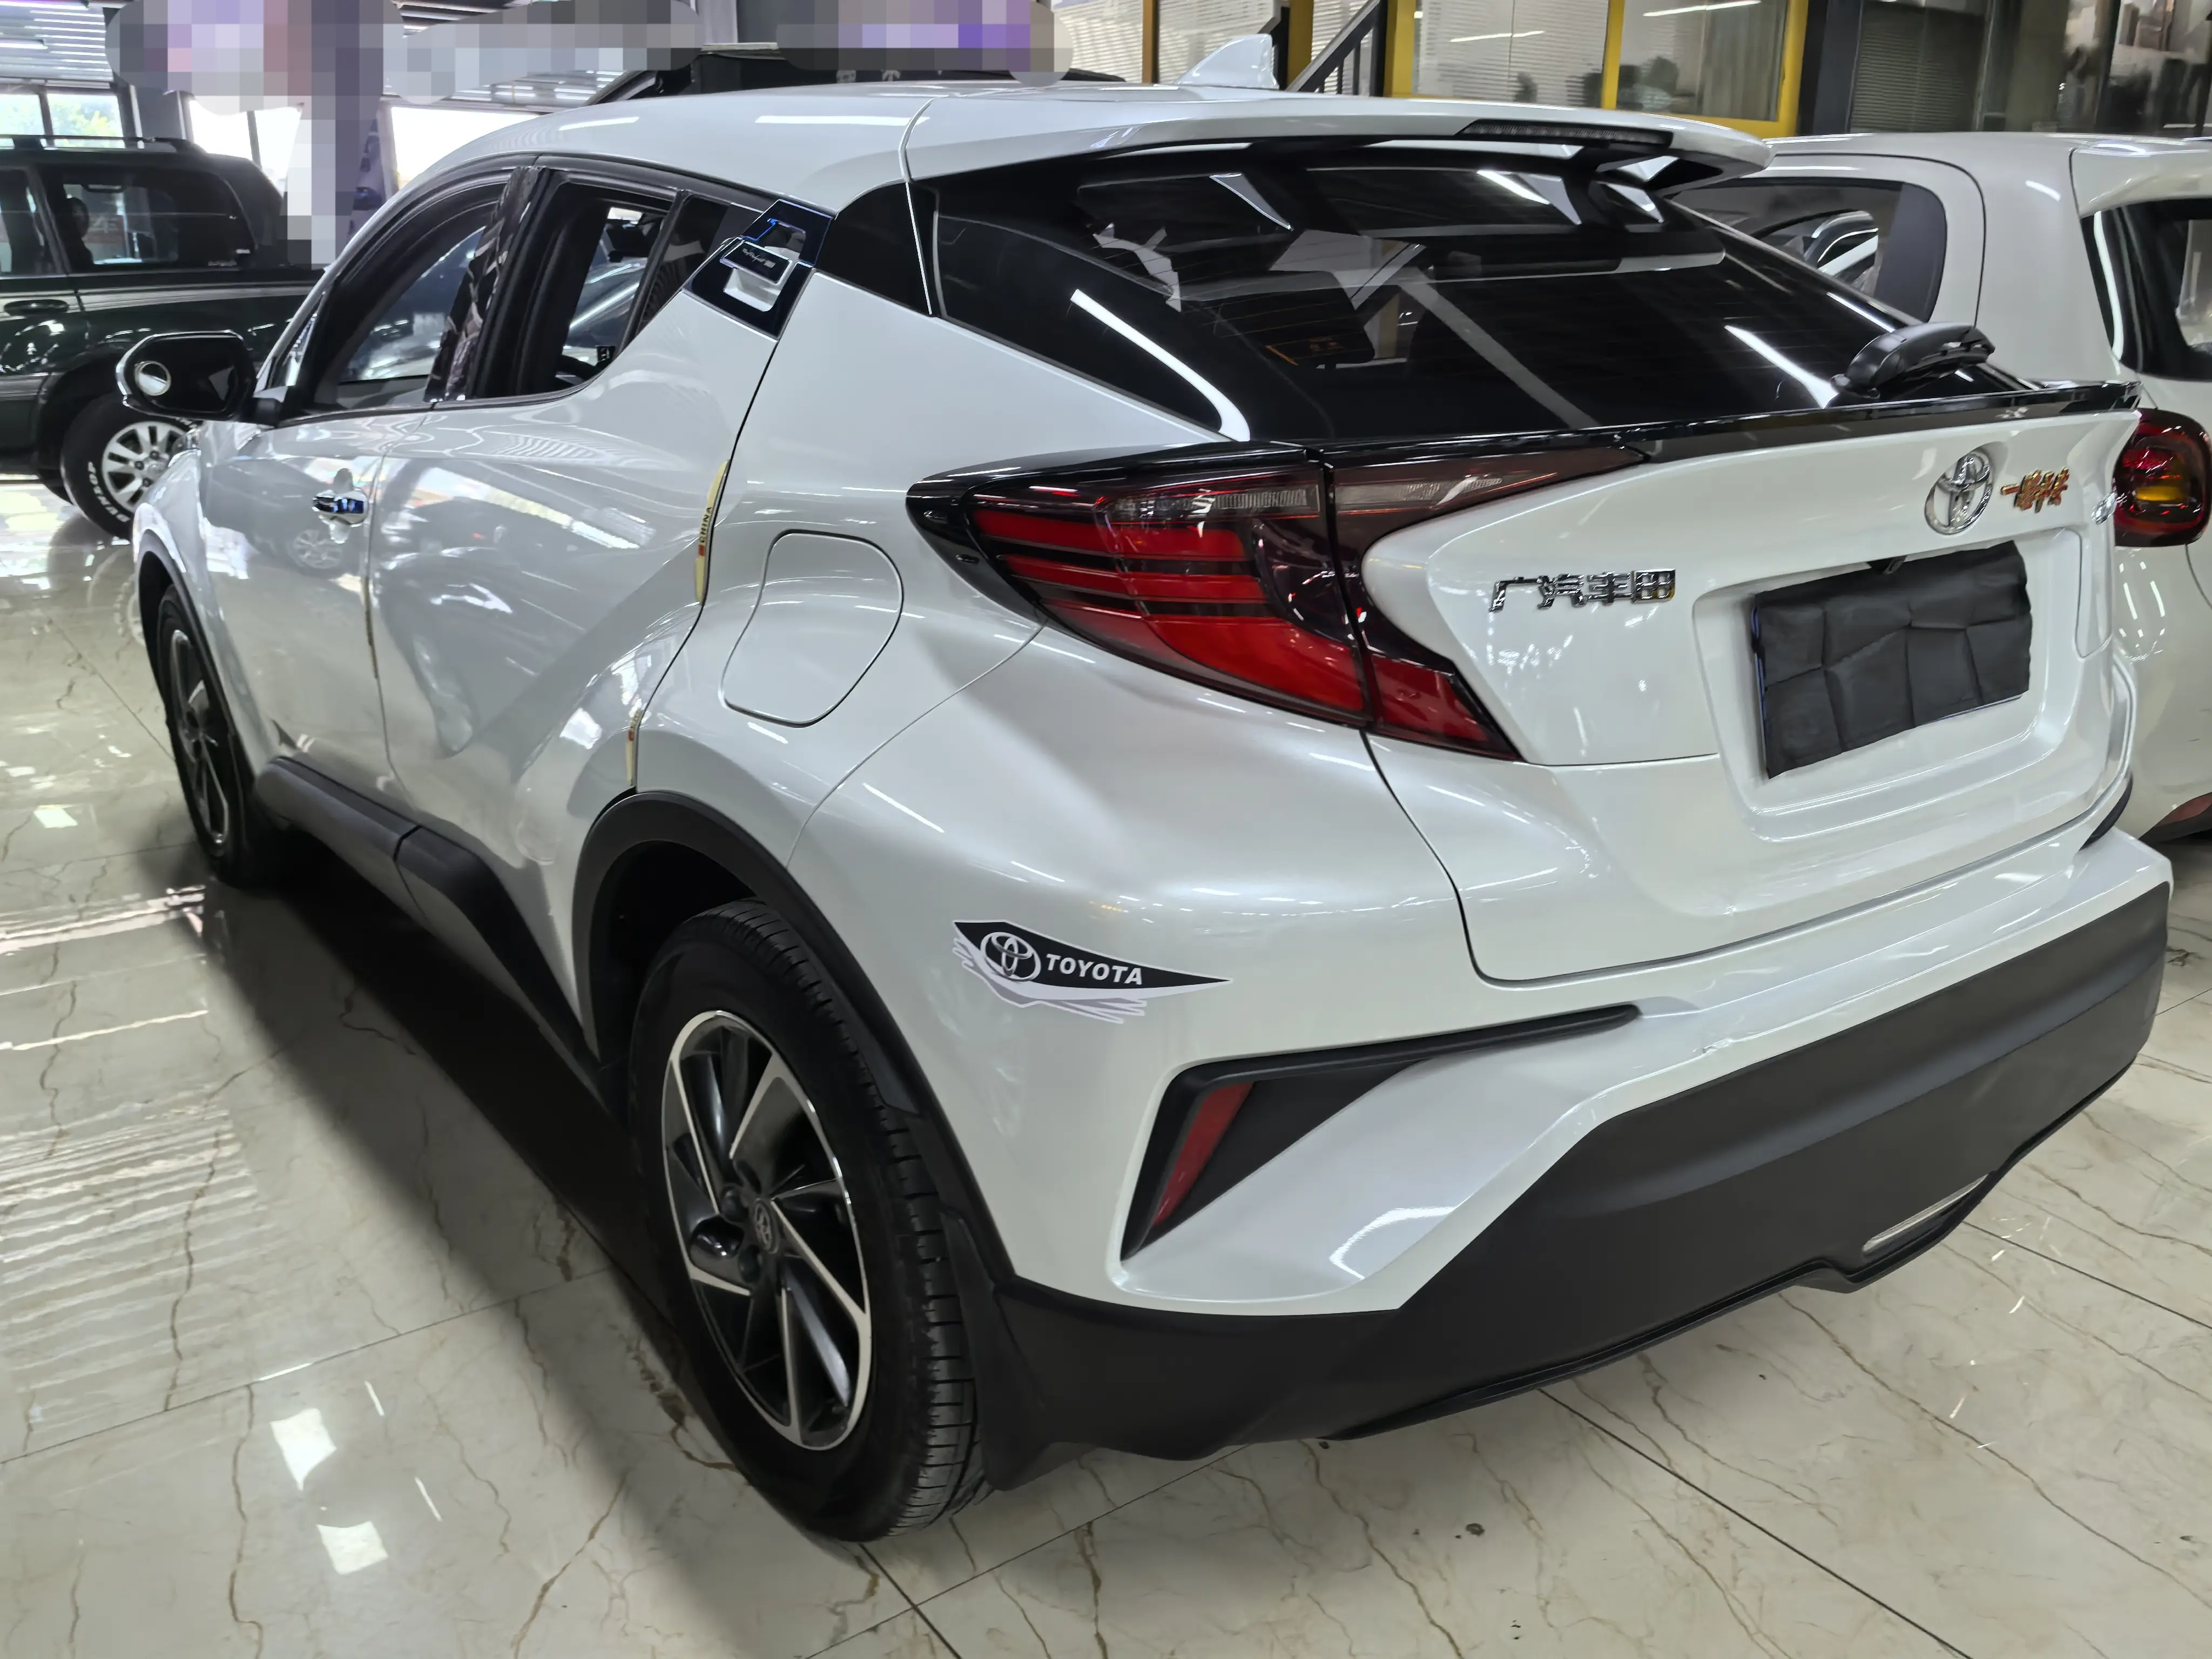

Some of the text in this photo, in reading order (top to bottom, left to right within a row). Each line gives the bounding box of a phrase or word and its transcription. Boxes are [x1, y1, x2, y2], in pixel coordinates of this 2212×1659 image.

[1489, 569, 1676, 612] 广汽丰田
[1046, 953, 1143, 986] TOYOTA
